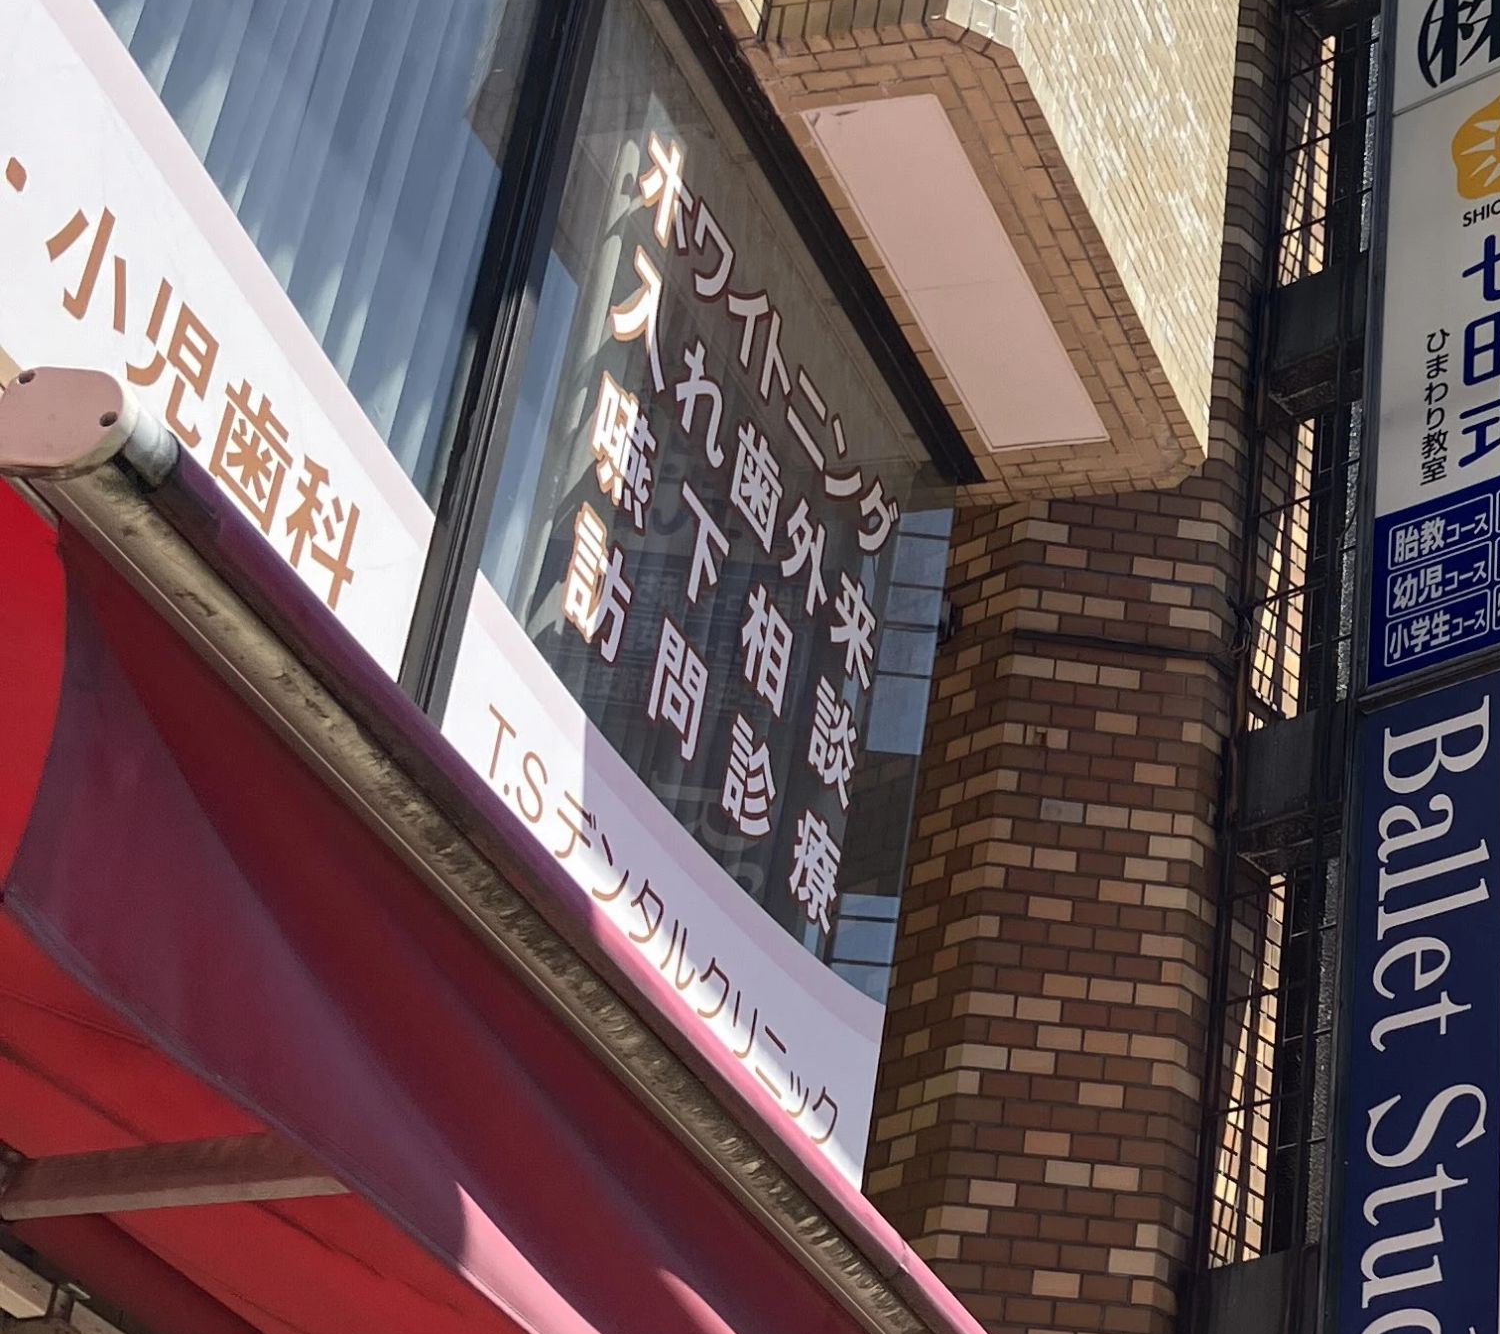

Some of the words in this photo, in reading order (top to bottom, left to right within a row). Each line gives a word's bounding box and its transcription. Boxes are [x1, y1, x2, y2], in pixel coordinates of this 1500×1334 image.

[610, 244, 878, 691] 入れ歯外来
[638, 130, 900, 552] ホワイトニング
[1419, 327, 1451, 487] ひまわり教室
[1388, 608, 1487, 660] 小学生コース
[1392, 560, 1488, 611] 幼児コース
[1393, 512, 1489, 564] 胎教コース
[562, 499, 844, 937] 訪問診療
[1371, 693, 1491, 1053] Ballet
